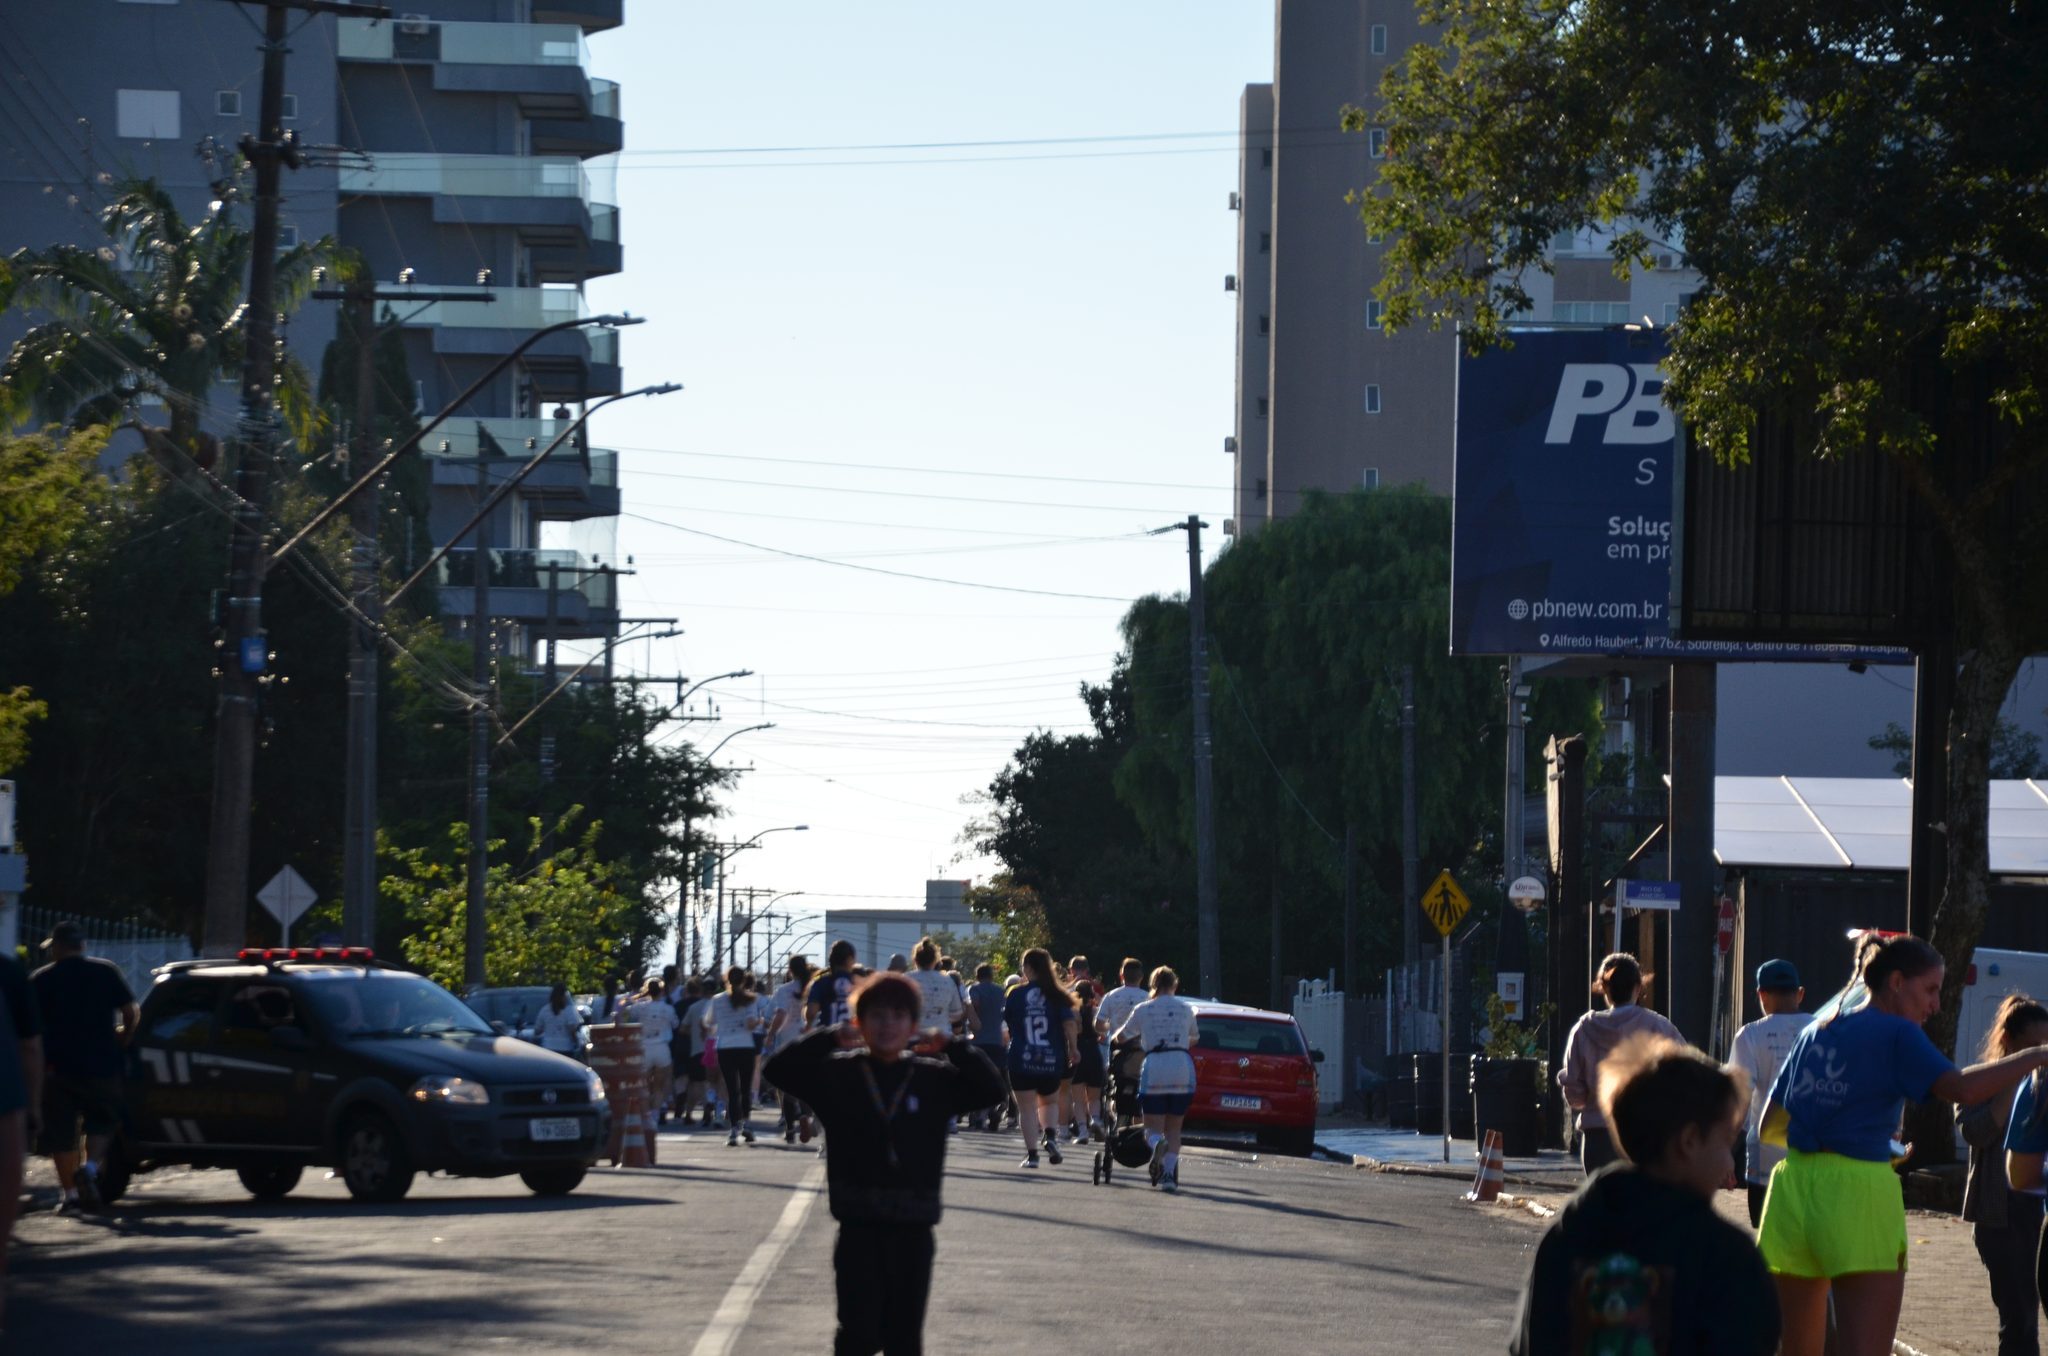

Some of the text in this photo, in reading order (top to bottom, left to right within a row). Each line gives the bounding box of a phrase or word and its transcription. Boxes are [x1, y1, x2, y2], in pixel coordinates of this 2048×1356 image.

[1608, 515, 1672, 541] Soluç
[1607, 543, 1672, 563] em pr
[1532, 598, 1663, 621] pbnew.com.br
[1552, 634, 1592, 647] Alfredo
[1719, 918, 1733, 932] PARE
[1025, 1016, 1050, 1045] 12
